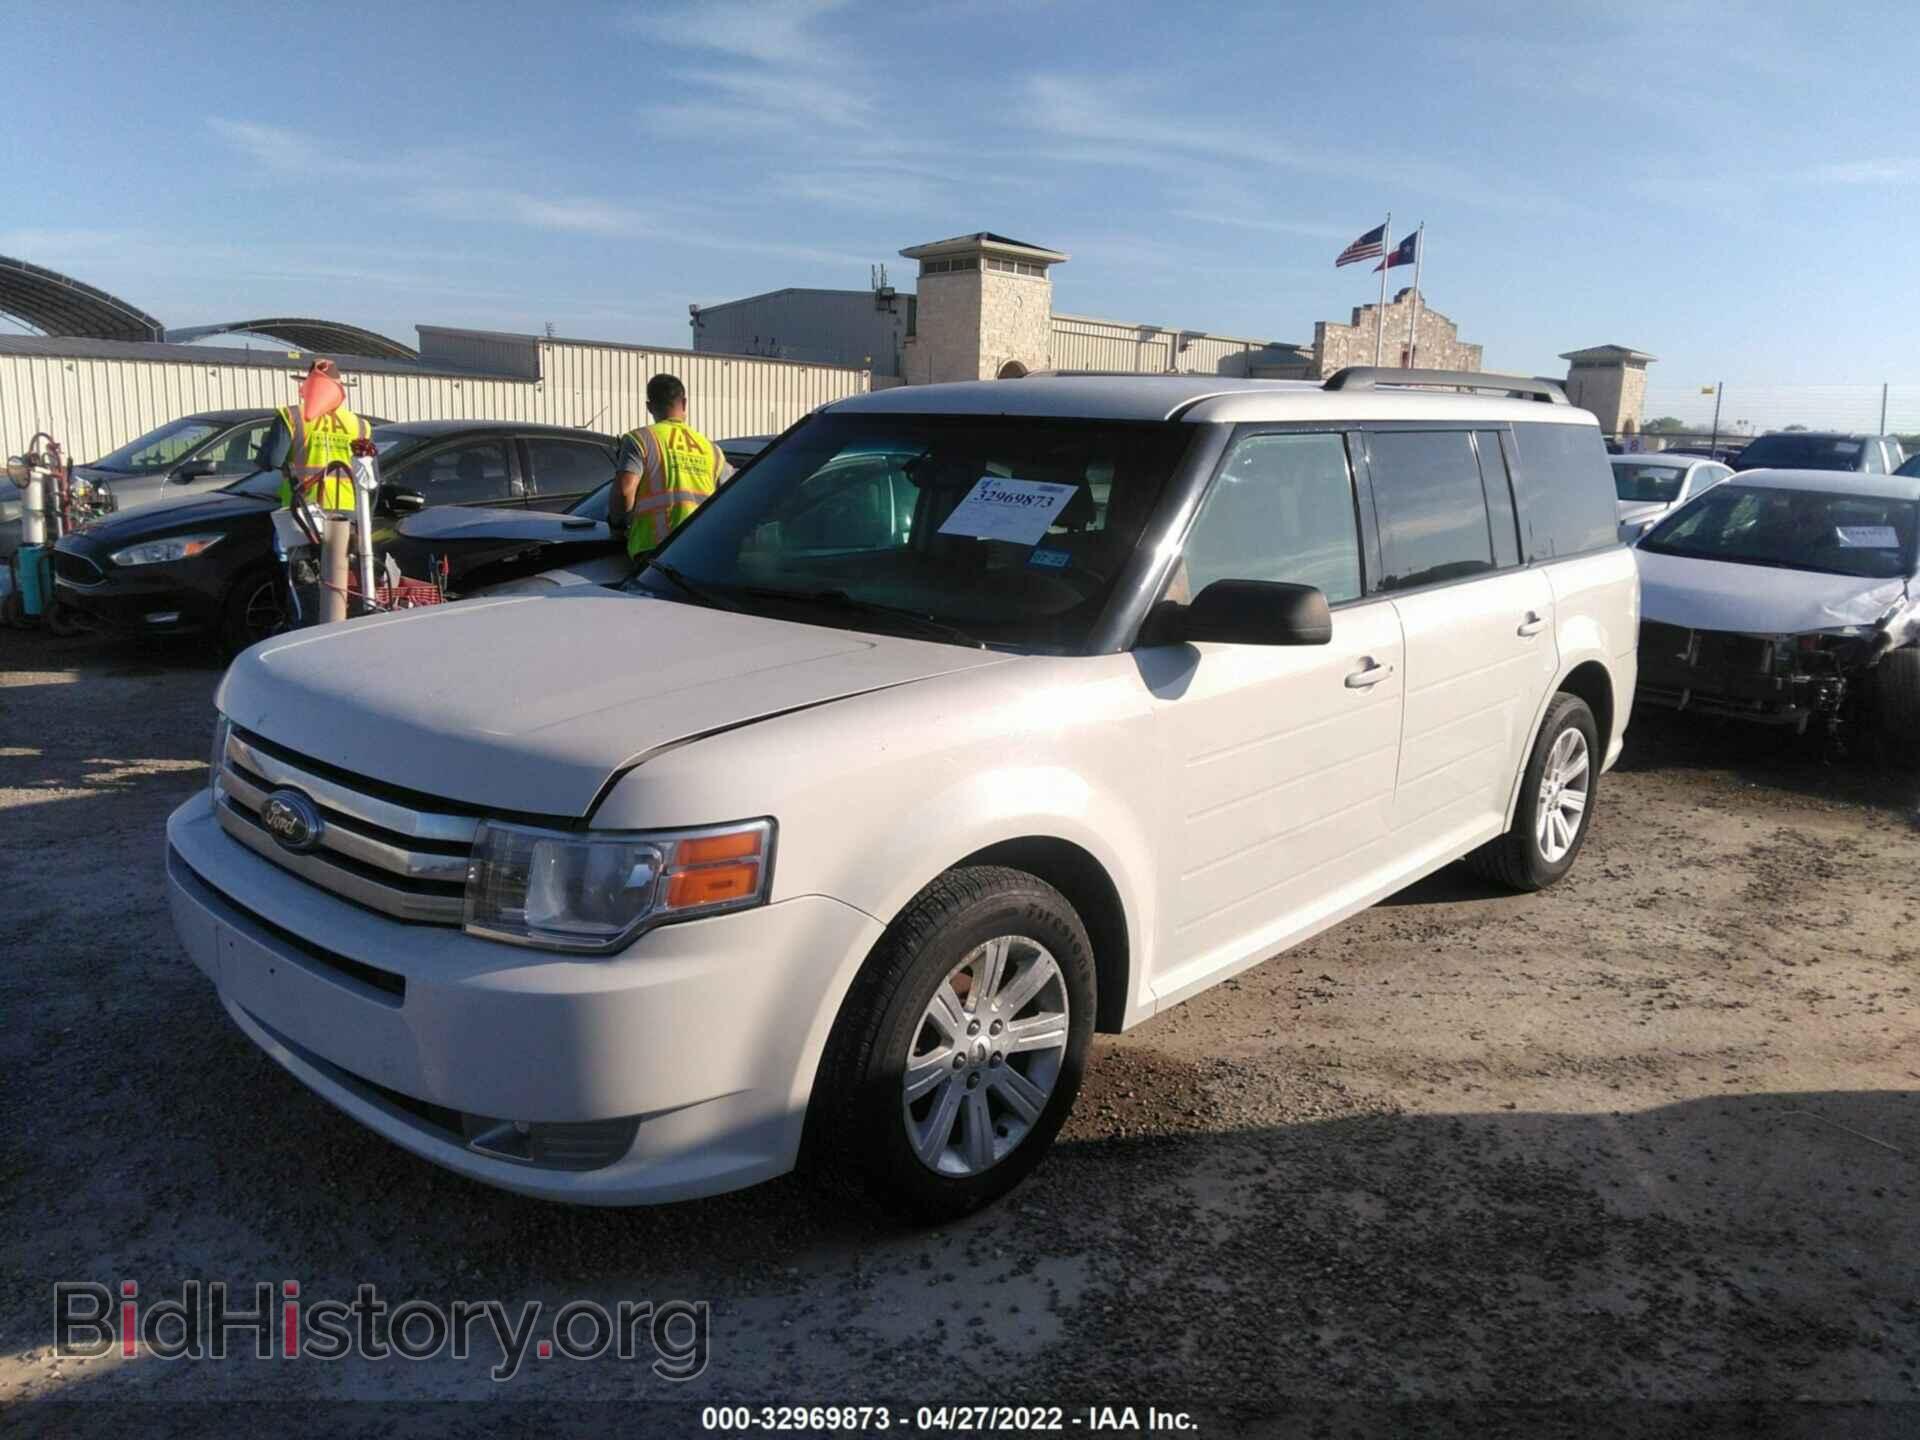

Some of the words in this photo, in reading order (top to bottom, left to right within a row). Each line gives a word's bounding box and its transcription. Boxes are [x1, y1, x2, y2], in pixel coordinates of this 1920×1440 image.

[669, 427, 705, 455] IAA
[973, 489, 1055, 509] 32969873
[266, 800, 298, 834] Ford
